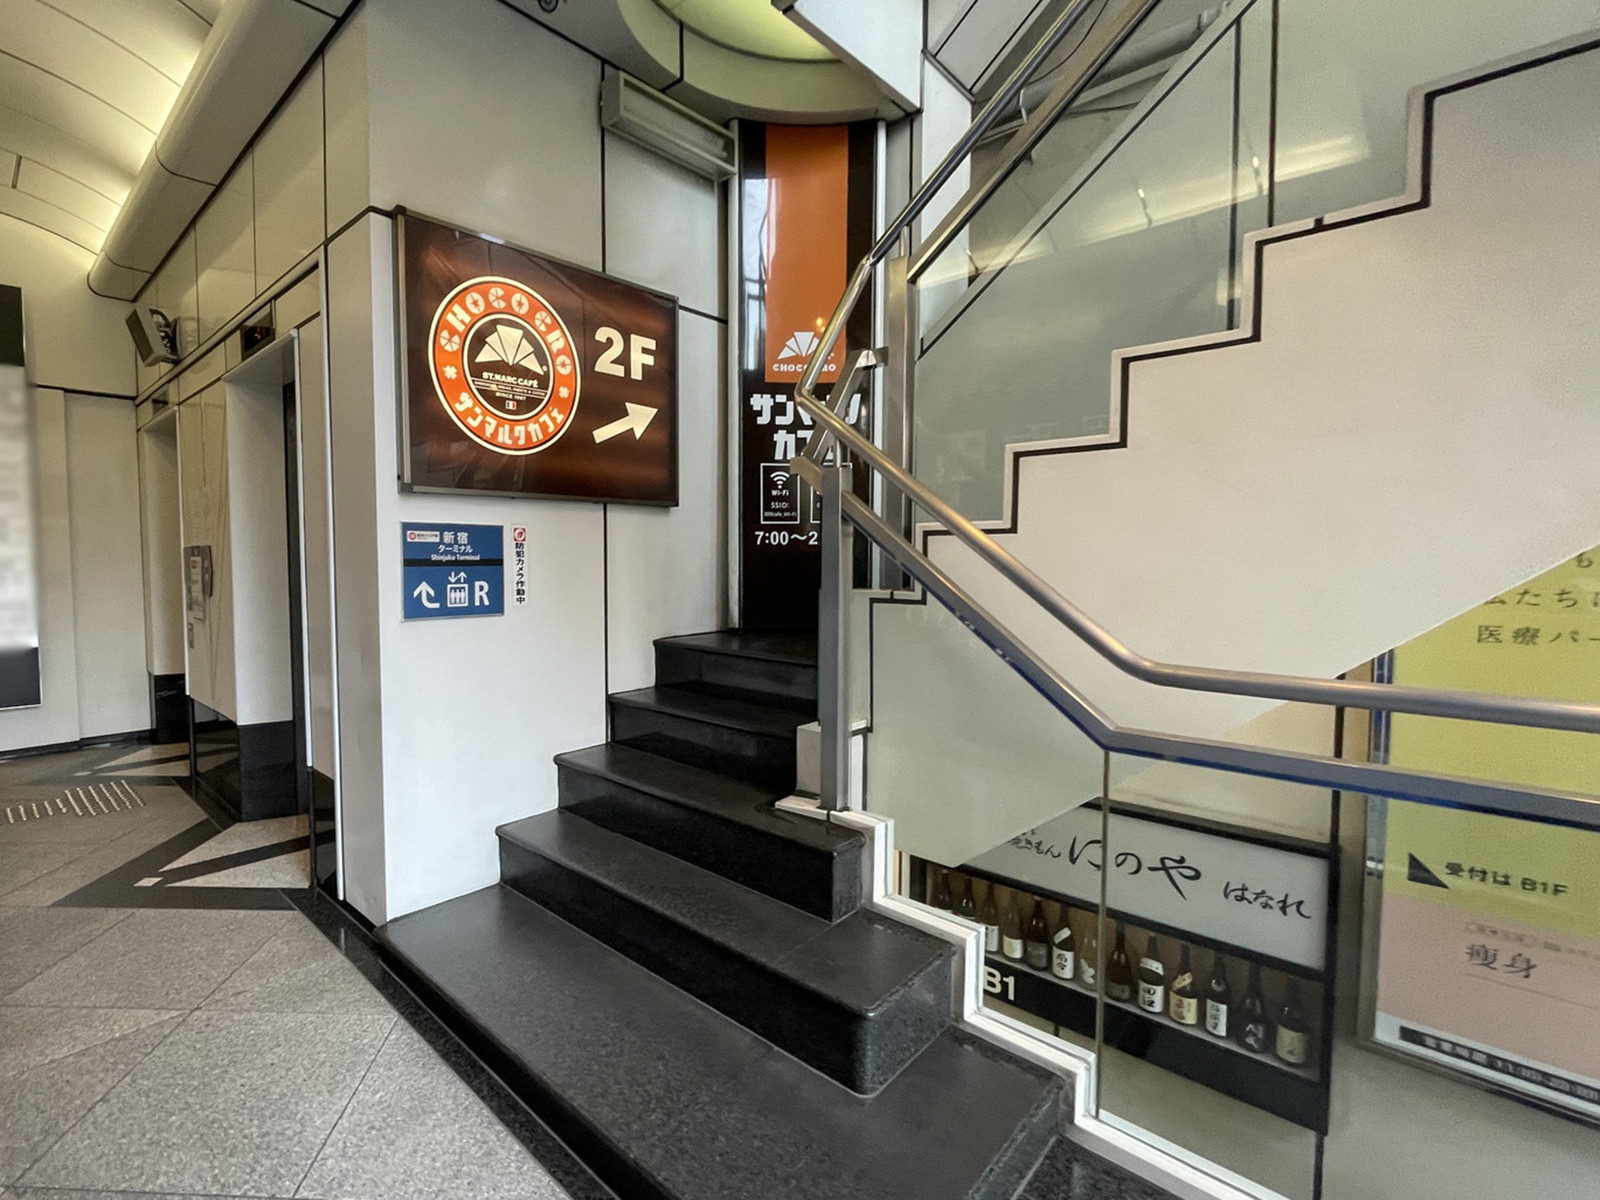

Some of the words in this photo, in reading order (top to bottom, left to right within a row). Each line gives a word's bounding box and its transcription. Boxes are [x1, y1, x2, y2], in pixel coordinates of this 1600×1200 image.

[594, 326, 657, 381] 2F
[454, 391, 565, 446] サンマルクカフェ
[438, 544, 474, 553] ターミナル
[443, 531, 469, 545] 新宿
[431, 554, 456, 562] Shinjuku
[514, 542, 526, 604] 防犯カメラ作動中
[474, 581, 490, 606] R
[1445, 862, 1511, 886] 受付は
[1521, 877, 1568, 896] B1F
[1223, 881, 1311, 919] はなれ
[983, 965, 1015, 1001] B1
